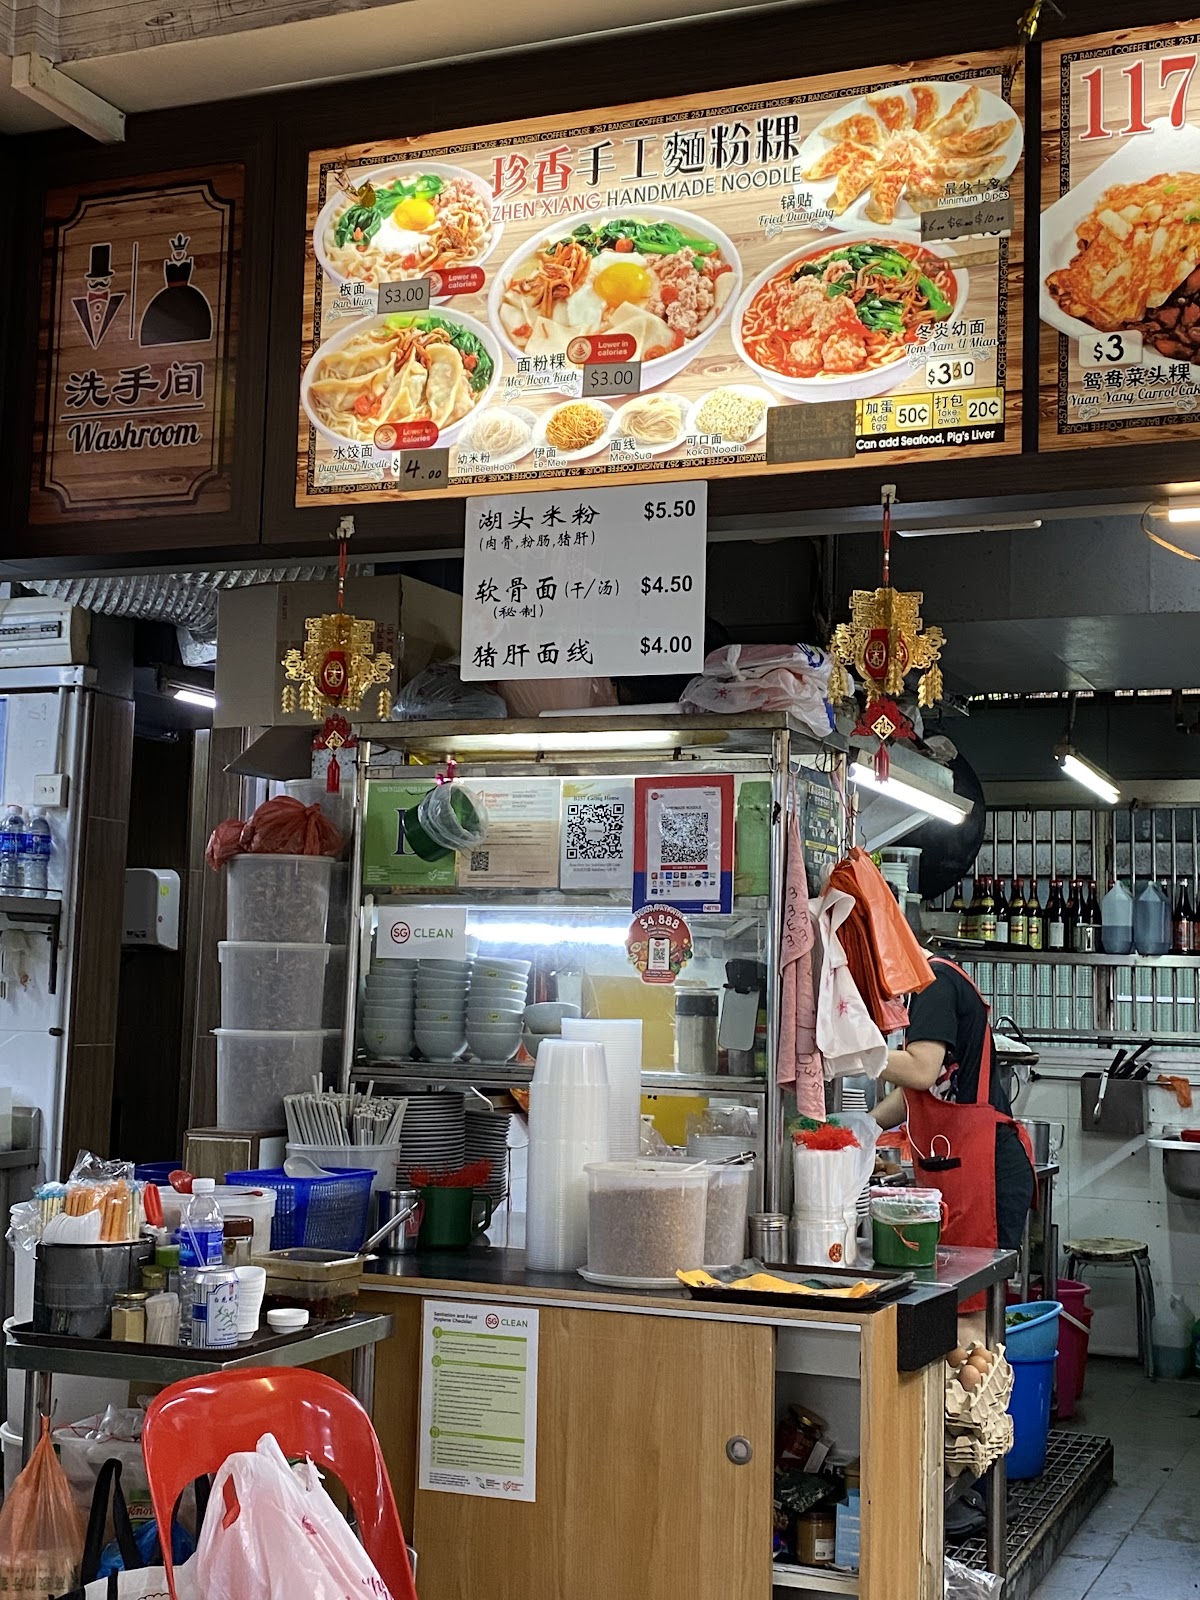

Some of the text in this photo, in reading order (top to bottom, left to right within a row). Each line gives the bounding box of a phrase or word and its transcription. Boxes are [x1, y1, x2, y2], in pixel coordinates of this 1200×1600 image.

[1063, 54, 1078, 63] 257
[1080, 48, 1112, 59] BANGKIT
[1114, 43, 1146, 54] COFFEE
[1179, 36, 1194, 45] 257
[361, 70, 978, 166] COFFEE 257 BANGKIT COFFEE 257 BANGKIT COFFEE 257 BANGKIT COFFEE 257 BANGKIT COFFEE 257 BANGKIT COFFEE COFFEE
[492, 114, 800, 199] 珍香手工麵粉粿
[493, 166, 802, 222] ZHEN XIANG HANDMADE NOODLE
[781, 192, 814, 210] 锅贴
[938, 196, 978, 206] Minimum
[992, 191, 1008, 200] pcs
[758, 208, 834, 226] Fried Dumpling
[448, 274, 469, 282] Lower
[448, 281, 476, 289] calories
[340, 282, 365, 296] 板面
[385, 287, 424, 305] $3.00
[332, 298, 372, 308] Ban Mian
[916, 319, 986, 340] 冬炎幼面
[598, 340, 629, 349] Lower in
[904, 337, 997, 354] Tom Yam U Mian
[1093, 334, 1124, 362] $3
[598, 349, 628, 357] calories
[998, 341, 1006, 376] COFFEE
[517, 353, 566, 374] 面粉粿
[504, 372, 578, 388] Mee Hoon Kueh
[591, 370, 633, 388] $3.00
[1059, 336, 1068, 424] 257 BANGKIT COFFEE
[1083, 362, 1191, 390] 鸳鸯菜头粿
[66, 362, 204, 407] 洗手间
[934, 394, 964, 409] 打包
[1069, 394, 1100, 406] Yuan
[1103, 391, 1134, 404] Yang
[1138, 386, 1176, 400] Carrot
[866, 400, 894, 414] 加蛋
[968, 400, 998, 418] 20¢
[870, 414, 888, 422] Add
[898, 406, 928, 424] 50¢
[938, 416, 960, 425] away
[872, 422, 886, 432] Egg
[1092, 418, 1160, 430] BANGKIT COFFEE
[68, 421, 201, 454] Washroom
[402, 428, 423, 436] Lower
[402, 435, 430, 443] calories
[856, 428, 996, 450] Can add Seafood, Pig's Liver
[610, 438, 636, 451] 面线
[687, 433, 722, 446] 可口面
[334, 444, 374, 460] 水饺面
[534, 446, 556, 458] 伊面
[610, 452, 652, 462] Mee Sua
[686, 444, 745, 456] Koka Noodle
[458, 452, 490, 464] 幼米粉
[666, 460, 680, 468] 257
[707, 456, 736, 466] COFFEE
[736, 454, 766, 463] BANGKIT
[318, 459, 388, 472] Dumpling Noodle
[458, 463, 516, 474] Thin Bee Hoon
[566, 468, 580, 476] 257
[608, 464, 634, 473] COFFEE
[636, 462, 665, 471] BANGKIT
[512, 472, 536, 480] COFFEE
[537, 470, 566, 478] BANGKIT
[331, 482, 396, 494] 257 BANGKIT COFFEE
[479, 502, 600, 531] 湖头米粉
[644, 500, 696, 520] $5.50
[640, 575, 692, 596] $4.50
[493, 604, 544, 620] (秘制)
[640, 636, 692, 656] $4.00
[472, 638, 594, 669] 猪肝面线
[394, 928, 454, 938] SG CLEAN
[501, 1319, 528, 1328] CLEAN
